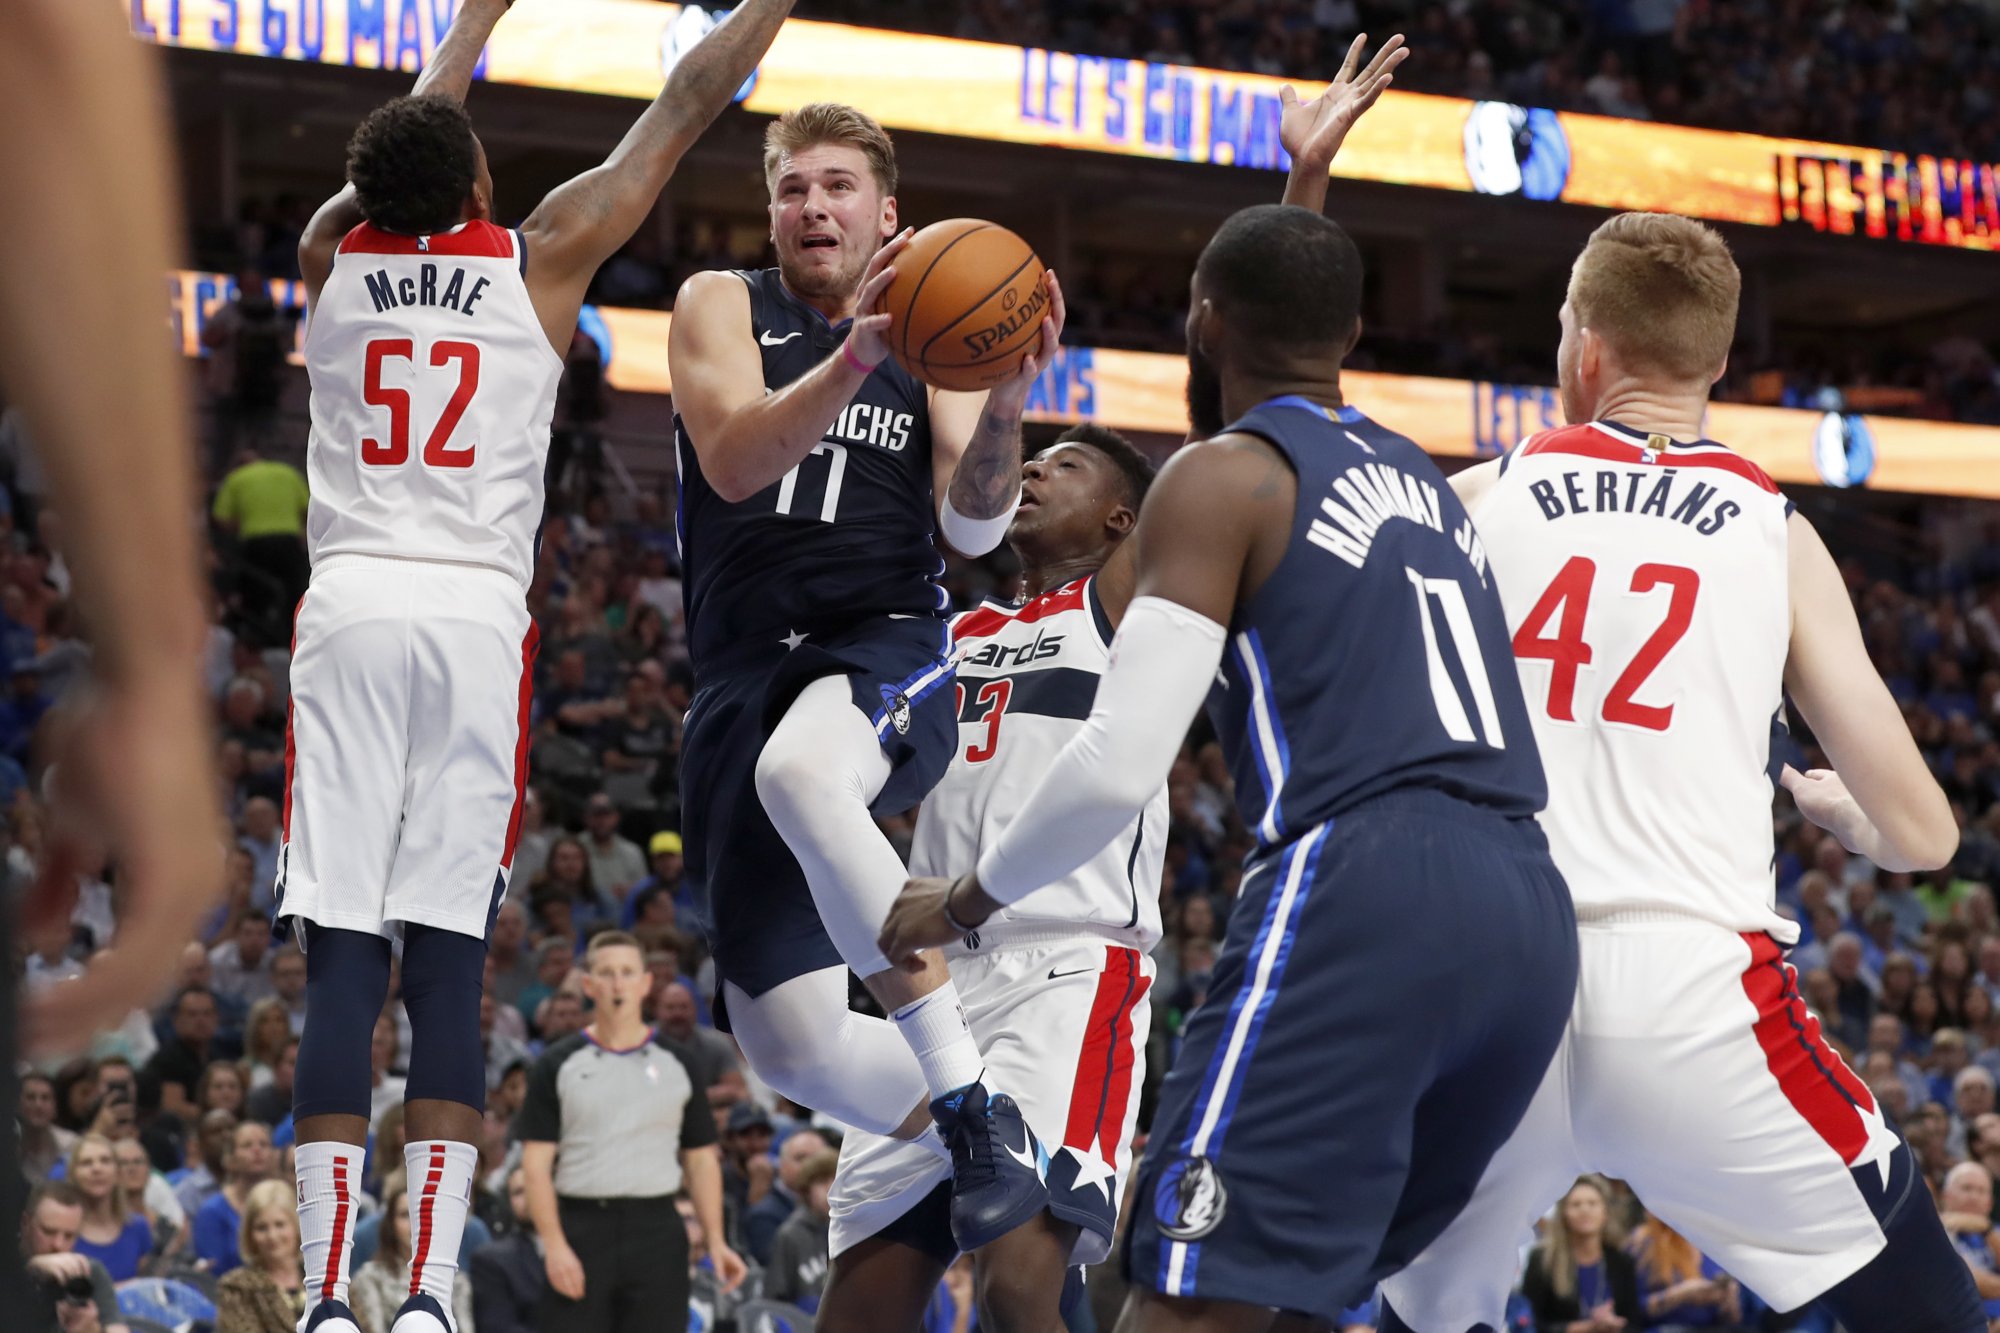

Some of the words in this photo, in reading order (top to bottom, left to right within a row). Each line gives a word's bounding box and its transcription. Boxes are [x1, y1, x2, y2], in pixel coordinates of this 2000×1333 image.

[363, 263, 491, 317] McRAE
[361, 338, 481, 468] 52
[825, 403, 915, 452] ICKS
[1529, 468, 1742, 536] BERTĀNS
[1404, 565, 1506, 750] 11
[1511, 555, 1701, 732] 42
[955, 678, 1014, 766] 3
